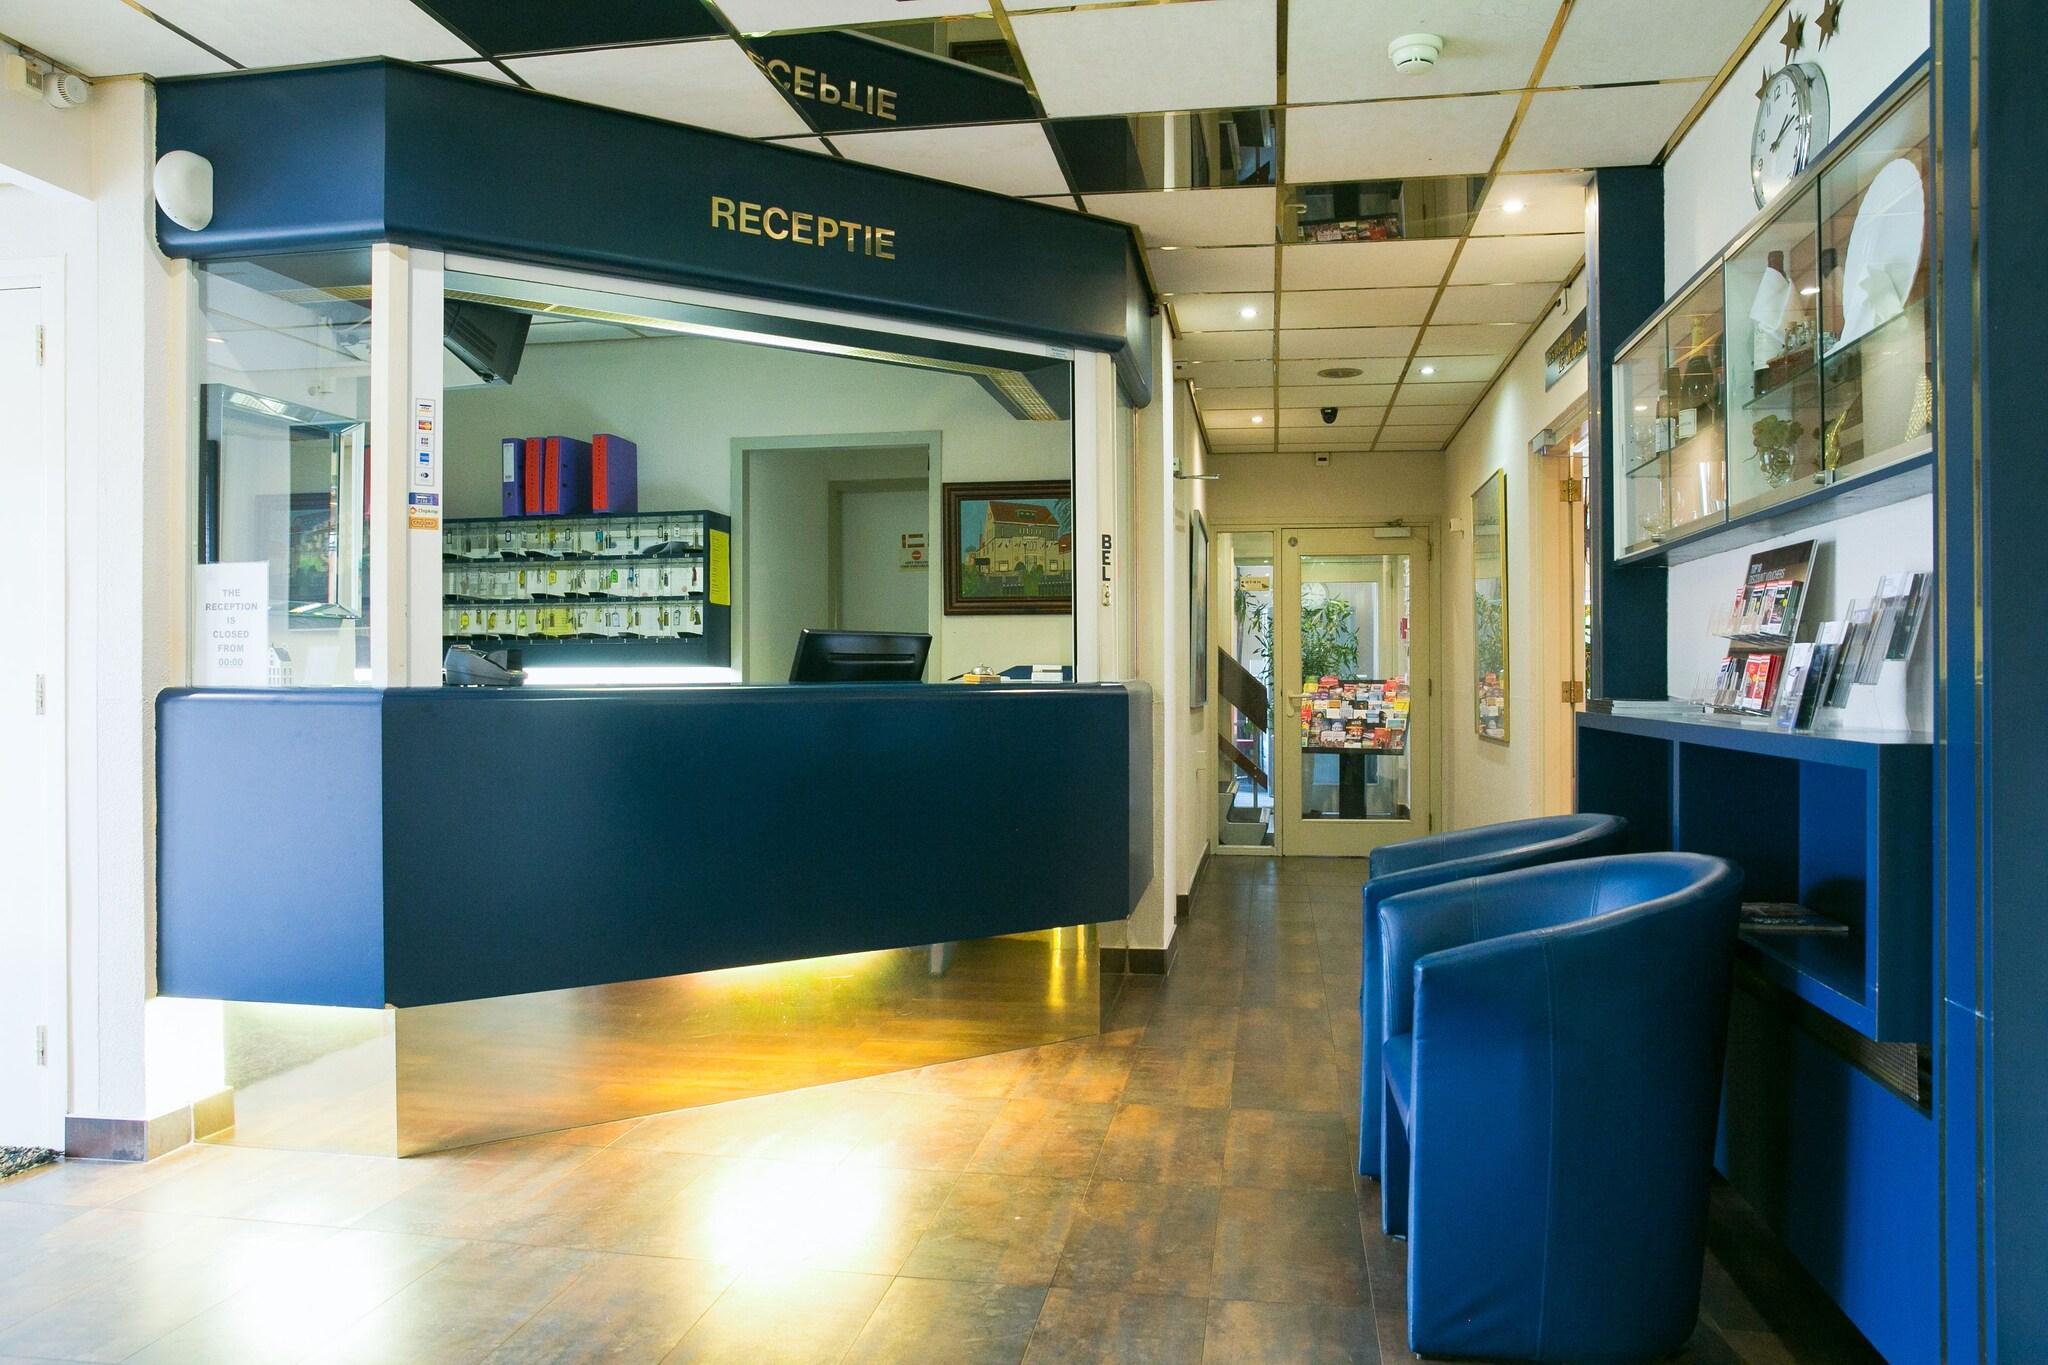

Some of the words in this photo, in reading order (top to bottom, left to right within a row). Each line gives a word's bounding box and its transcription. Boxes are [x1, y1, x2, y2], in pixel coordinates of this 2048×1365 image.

[711, 195, 896, 260] RECEPTIE
[1101, 534, 1112, 582] BEL
[222, 589, 241, 597] THE
[205, 602, 258, 611] RECEPTION
[226, 616, 236, 625] IS
[212, 630, 249, 639] CLOSED
[217, 644, 244, 652] FROM
[218, 658, 243, 666] 00:00
